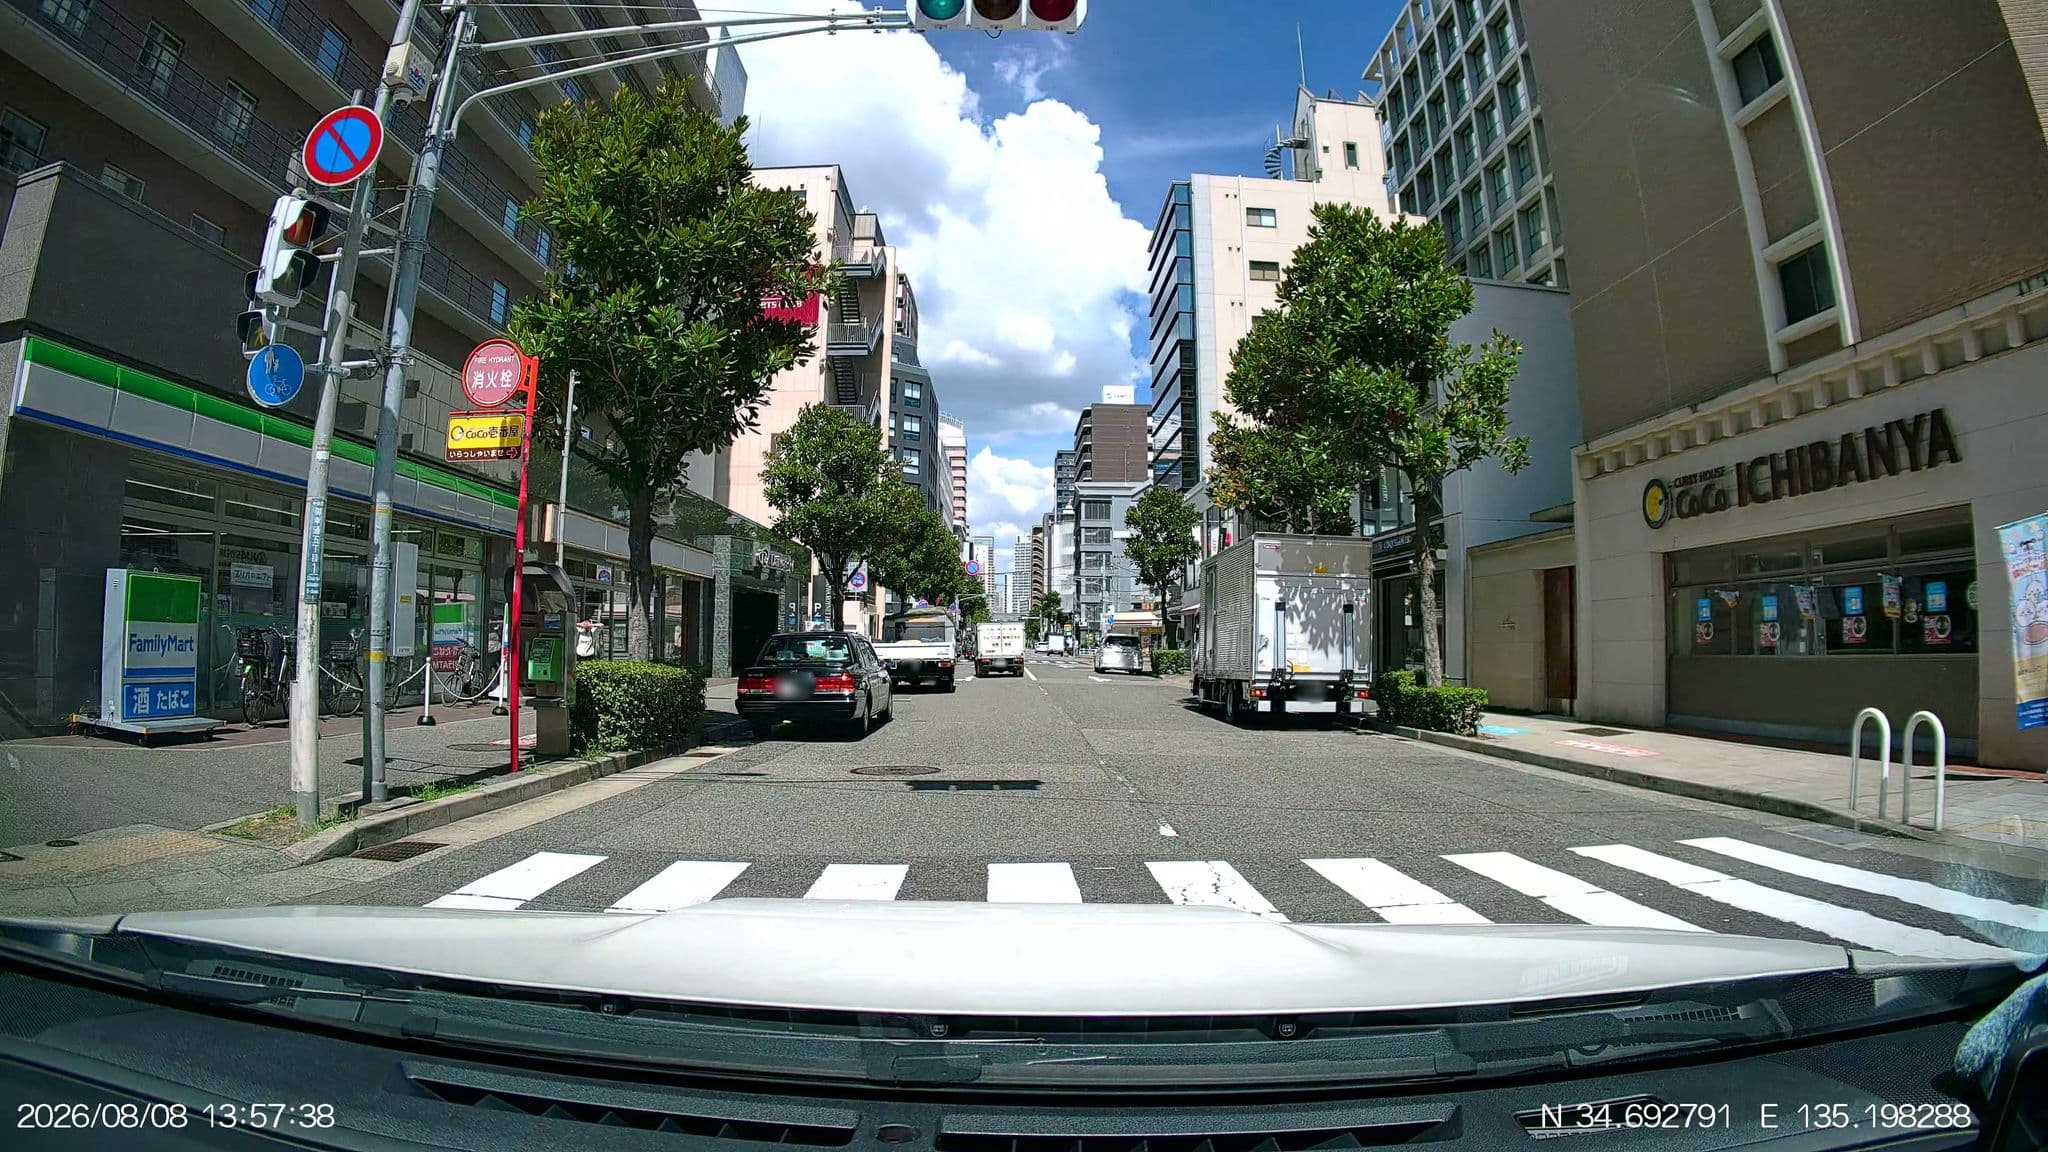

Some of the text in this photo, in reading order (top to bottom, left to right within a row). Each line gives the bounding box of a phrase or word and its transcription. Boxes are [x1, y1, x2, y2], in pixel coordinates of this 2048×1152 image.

[474, 355, 515, 364] FIRE HYDRANT
[471, 369, 513, 389] 消火栓
[465, 425, 519, 439] CoCo壱番屋
[449, 449, 505, 458] いらっしゃいませ
[1676, 408, 1964, 519] CoCo ICHIBANYA
[1674, 466, 1726, 489] CURRY HOUSE
[129, 633, 194, 657] FamilyMart
[133, 687, 190, 714] 酒 たばこ
